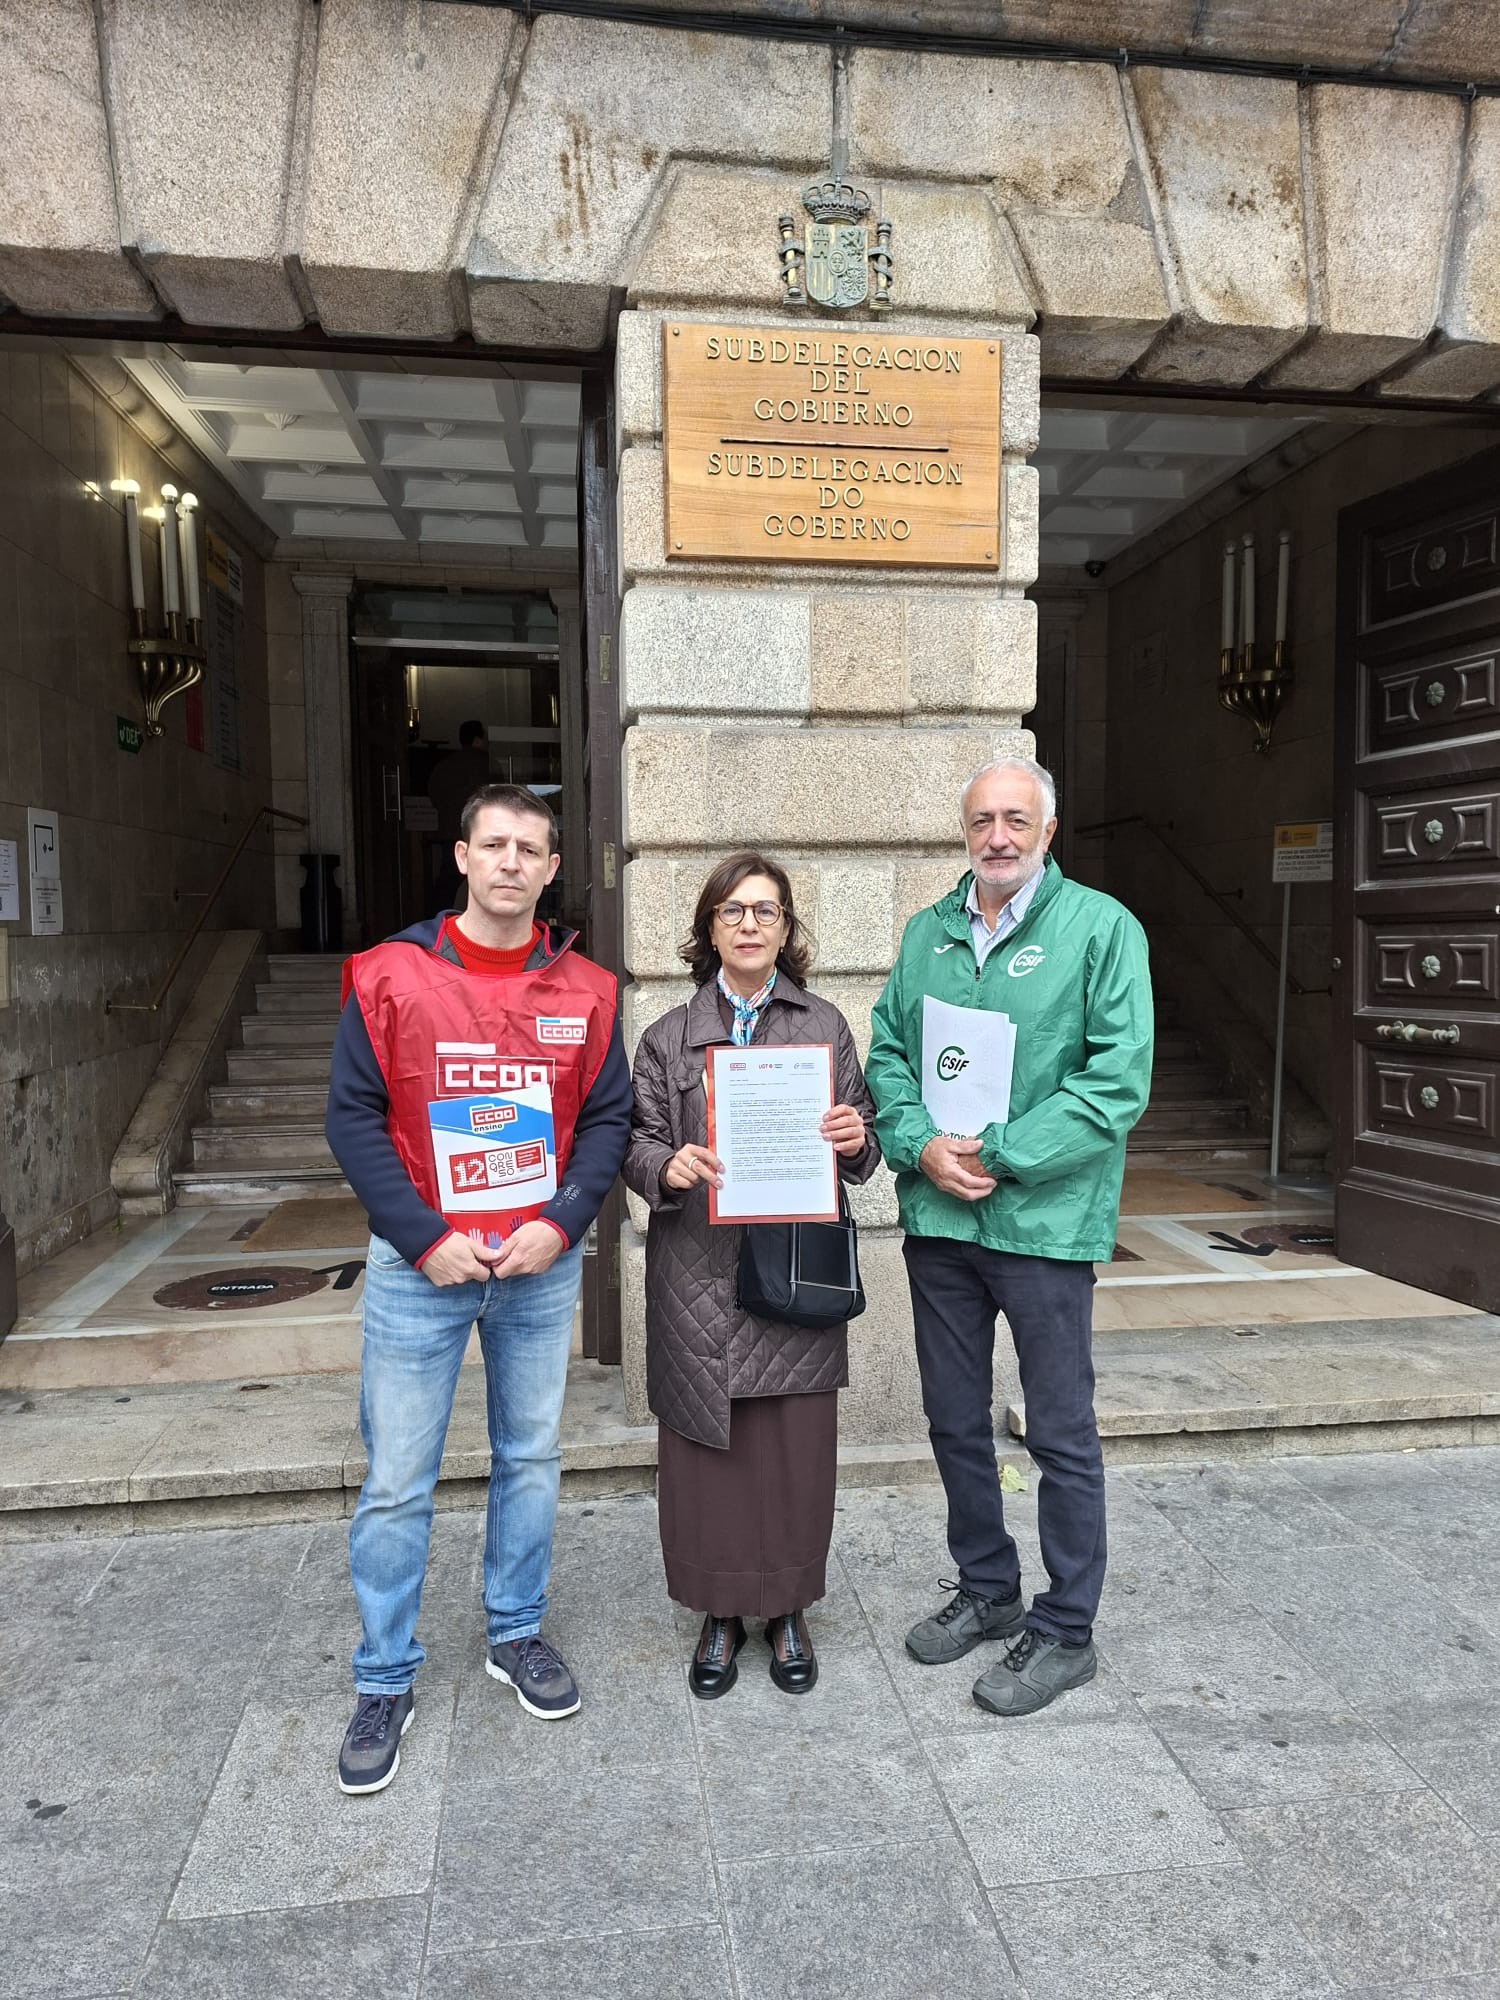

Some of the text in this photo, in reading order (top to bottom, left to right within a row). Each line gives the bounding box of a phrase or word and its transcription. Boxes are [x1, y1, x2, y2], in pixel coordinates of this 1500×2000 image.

[707, 336, 962, 373] SUBDELEGACION
[811, 369, 870, 394] DEL
[754, 398, 913, 427] GOBIERNO
[707, 452, 963, 485] SUBDELEGACION
[819, 486, 864, 508] DO
[763, 514, 911, 541] GOBERNO
[542, 1026, 583, 1038] CCOO
[445, 1063, 549, 1088] CCOO
[941, 1055, 970, 1072] CSIF
[474, 1109, 513, 1123] CCOO
[474, 1123, 503, 1133] ensino
[453, 1158, 487, 1188] 12
